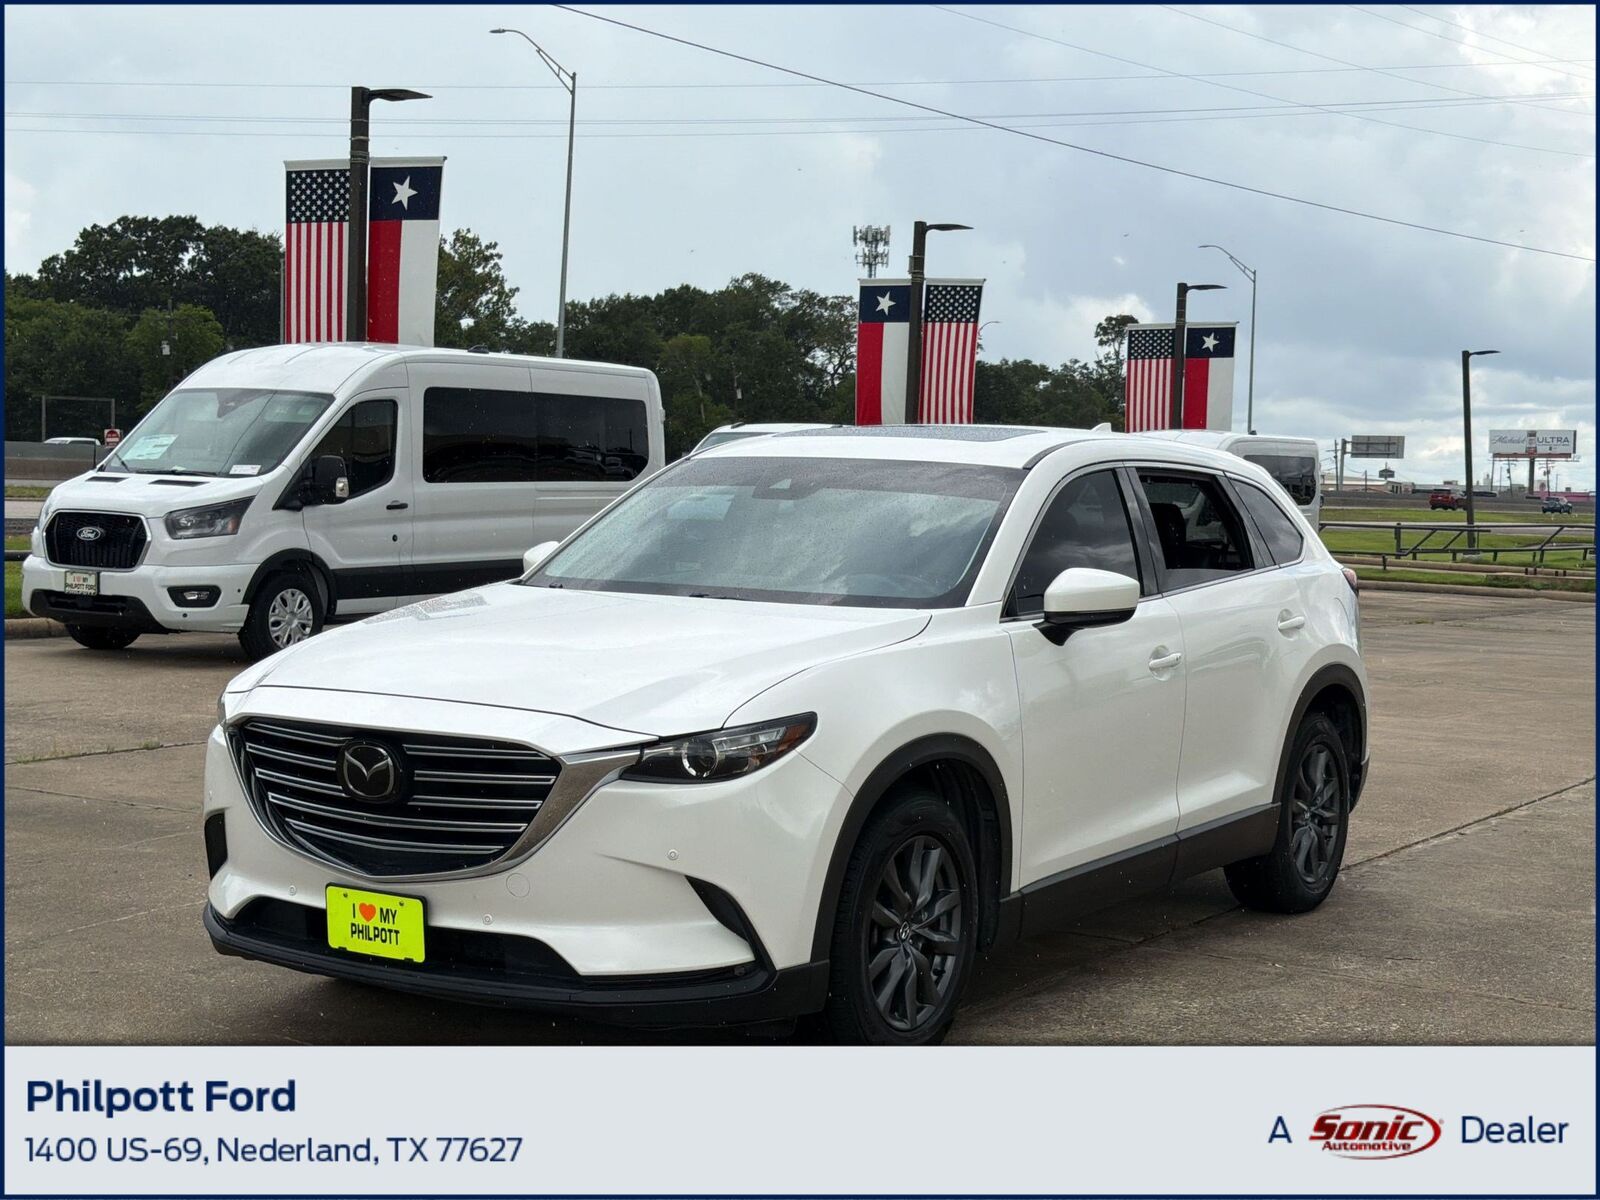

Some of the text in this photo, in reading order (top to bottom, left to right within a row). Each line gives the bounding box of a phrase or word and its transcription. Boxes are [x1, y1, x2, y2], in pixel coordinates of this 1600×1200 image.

[81, 529, 96, 538] Ford
[352, 903, 397, 924] I MY
[351, 923, 400, 945] PHILPOTT
